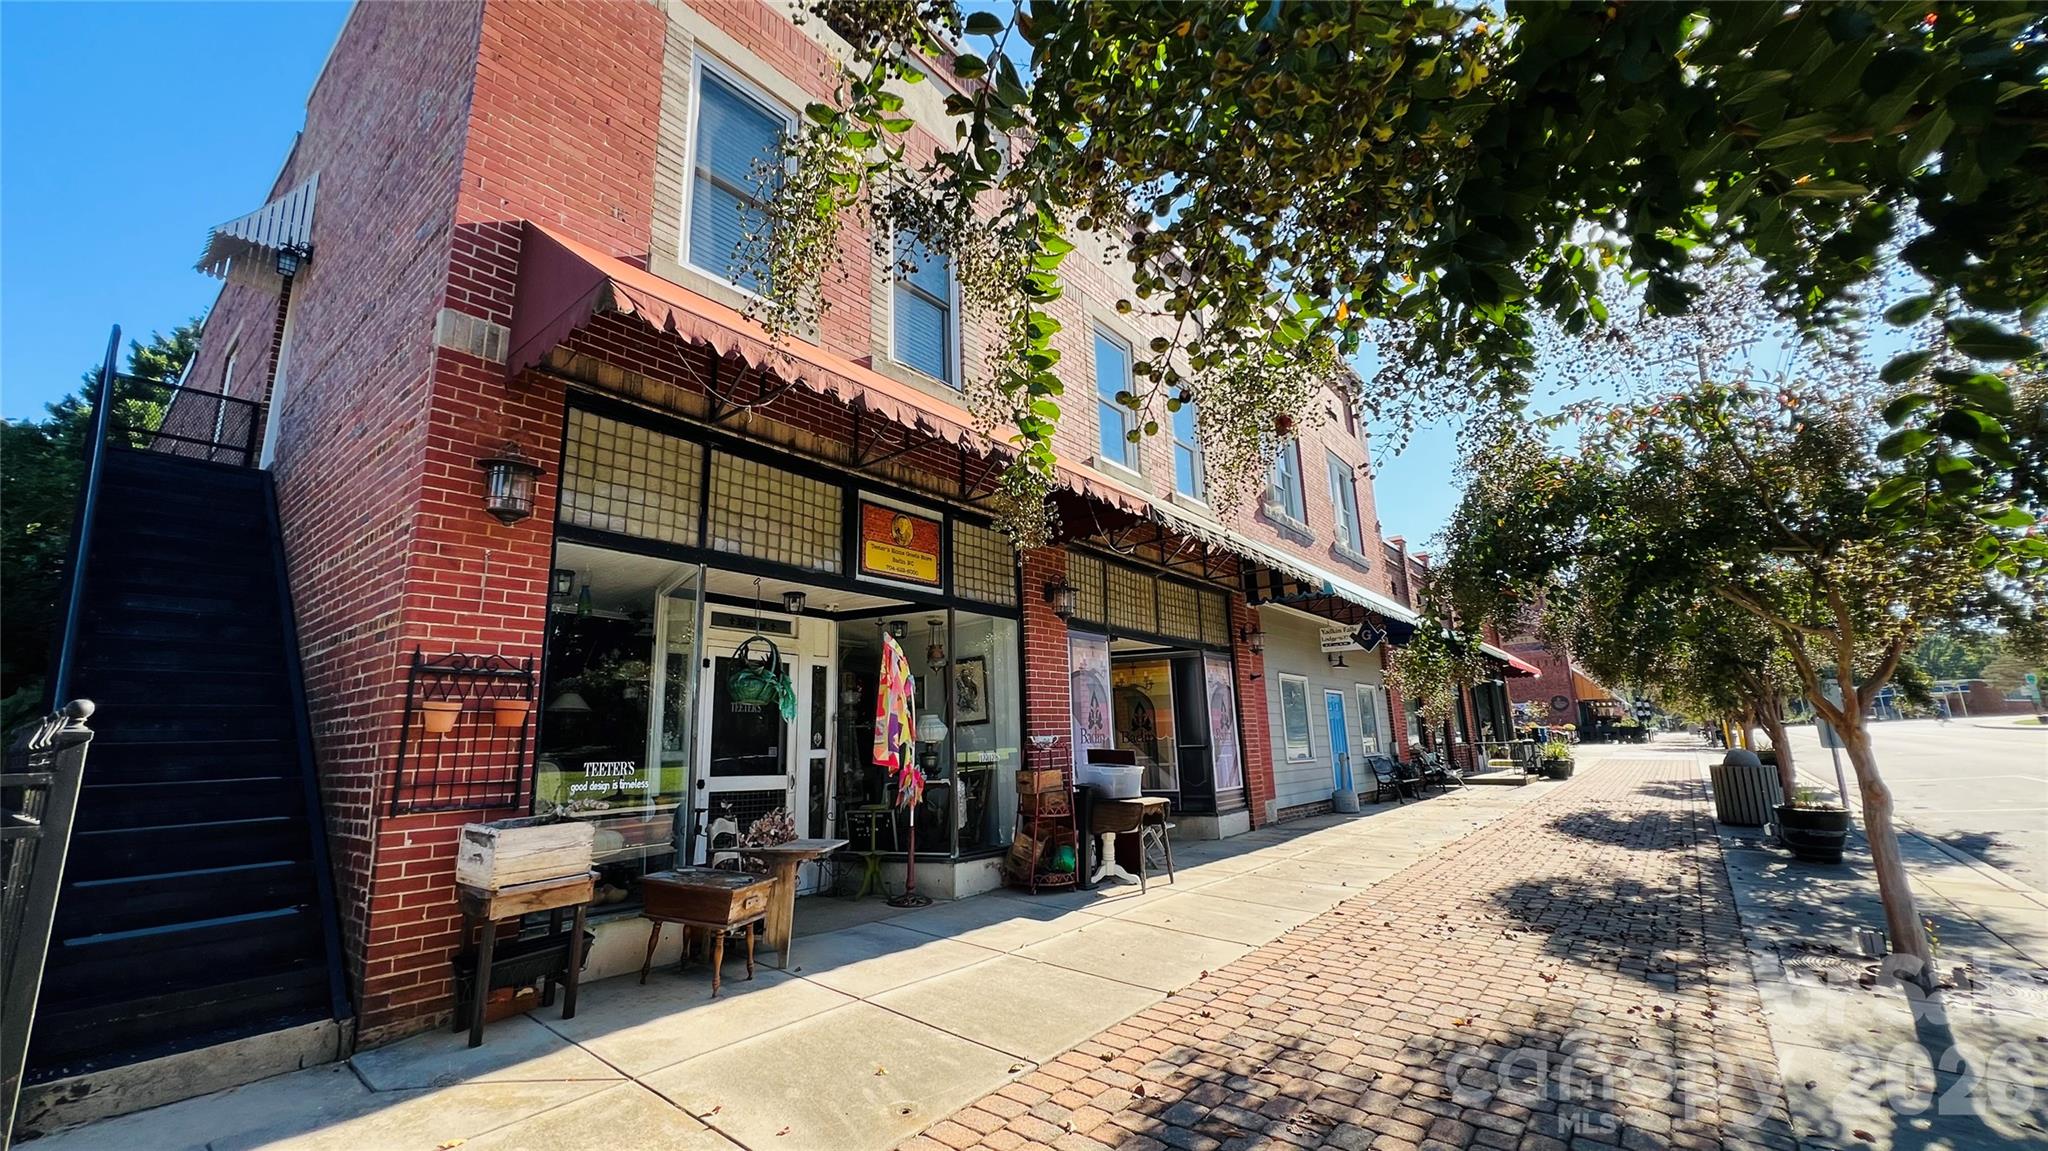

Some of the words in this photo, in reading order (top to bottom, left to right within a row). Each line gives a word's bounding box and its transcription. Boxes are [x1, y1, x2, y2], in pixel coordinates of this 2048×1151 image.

[1361, 630, 1372, 640] G
[731, 702, 762, 713] TEETERS
[1080, 727, 1105, 744] Badin
[1121, 730, 1155, 744] Badin
[583, 761, 635, 777] TEETER'S
[570, 781, 588, 796] good
[589, 780, 610, 794] design
[612, 779, 618, 790] is
[619, 778, 649, 790] timeless
